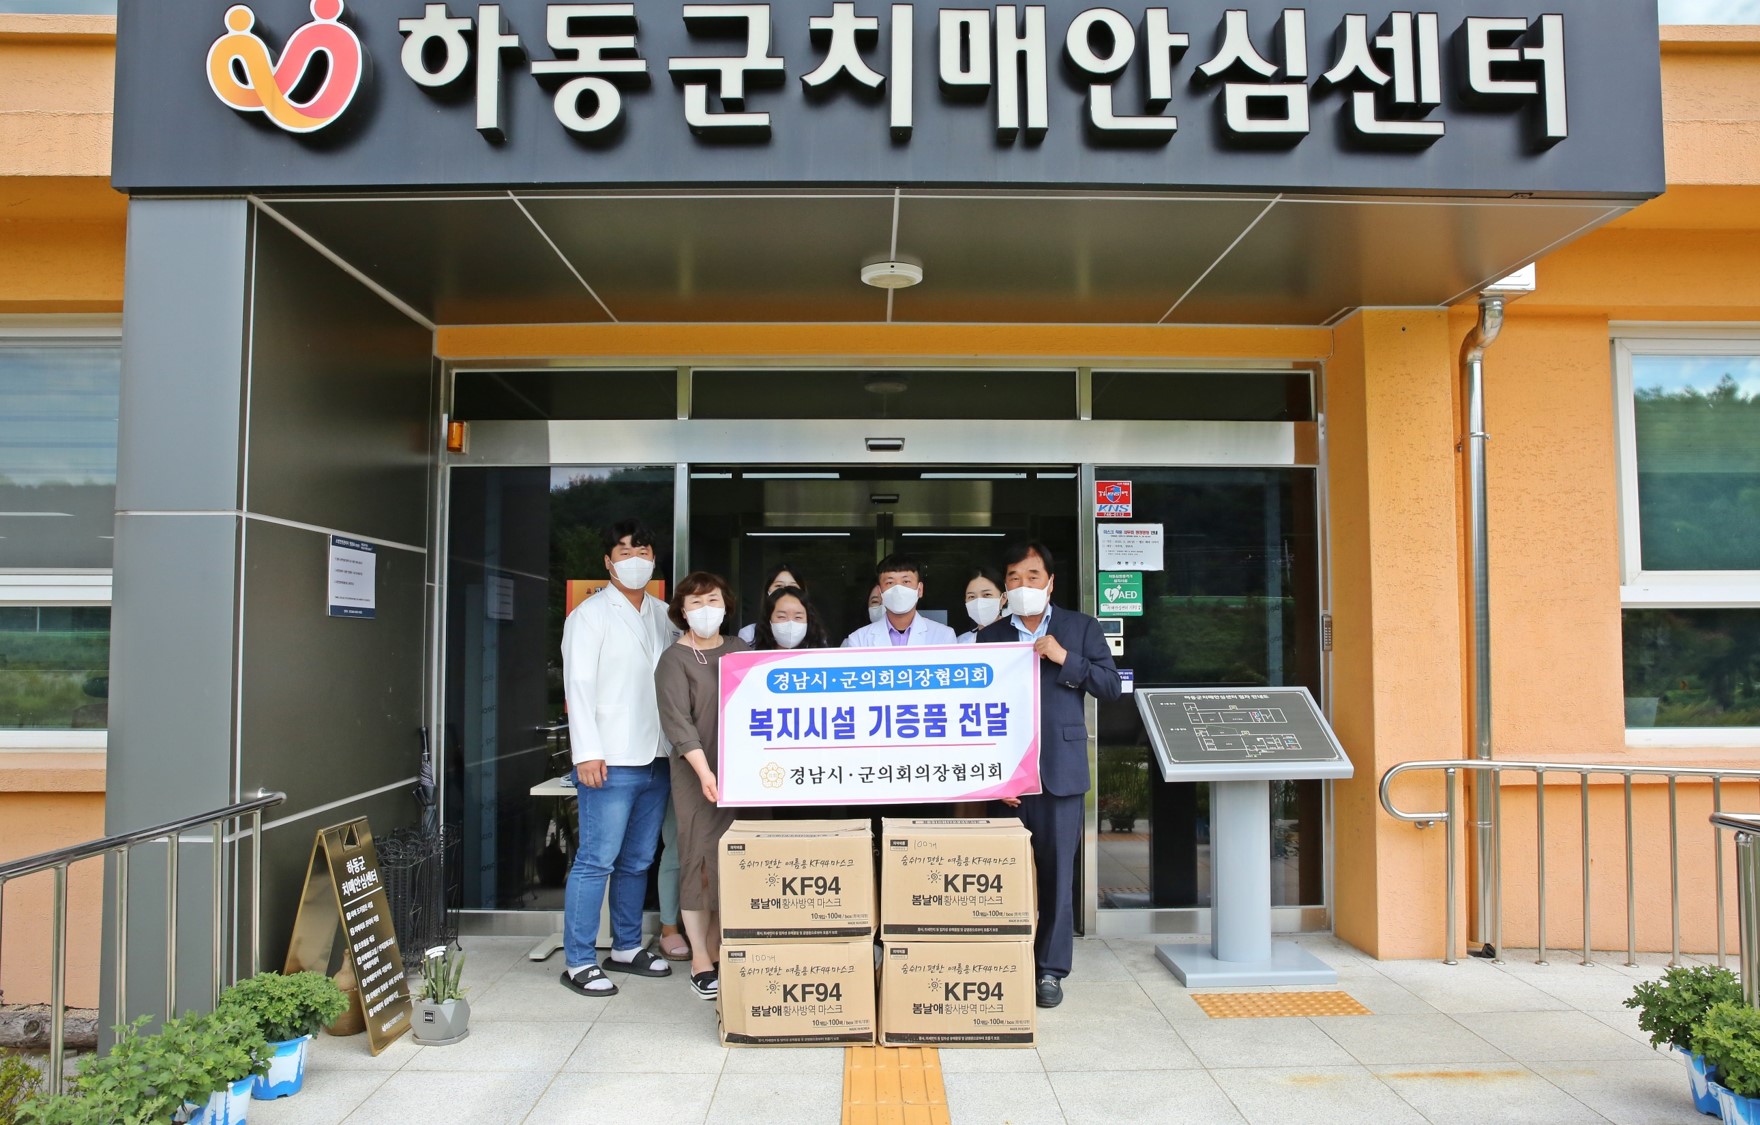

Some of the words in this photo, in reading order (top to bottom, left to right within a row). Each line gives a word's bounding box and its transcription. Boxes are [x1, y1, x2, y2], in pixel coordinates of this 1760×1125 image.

[398, 2, 1569, 138] 하동군치매안심센터
[1098, 504, 1130, 512] KNS
[1118, 590, 1138, 599] AED
[773, 666, 989, 692] 경남시·군의회의장협의회
[749, 705, 856, 742] 복지시설
[868, 703, 948, 739] 기증품
[959, 701, 1010, 738] 전달
[789, 761, 1003, 786] 경남시·군의회의장협의회
[346, 855, 366, 875] 하동군
[765, 858, 782, 869] 편한
[785, 858, 808, 870] 여름용
[927, 855, 945, 866] 편한
[947, 855, 970, 867] 여름용
[341, 868, 379, 897] 치매안심센터
[781, 876, 842, 897] KF94
[944, 873, 1004, 894] KF94
[750, 897, 781, 910] 봄날애
[782, 898, 815, 910] 황사방역
[817, 898, 842, 908] 마스크
[911, 895, 943, 907] 봄날애
[943, 895, 977, 907] 황사방역
[978, 896, 1004, 905] 마스크
[765, 966, 783, 976] 편한
[785, 965, 809, 977] 여름용
[927, 963, 945, 974] 편한
[947, 963, 971, 975] 여름용
[782, 982, 843, 1003] KF94
[944, 981, 1005, 1002] KF94
[751, 1005, 783, 1018] 봄날애
[783, 1005, 816, 1017] 황사방역
[818, 1005, 843, 1015] 마스크
[912, 1003, 944, 1015] 봄날애
[944, 1003, 978, 1015] 황사방역
[979, 1003, 1005, 1014] 마스크
